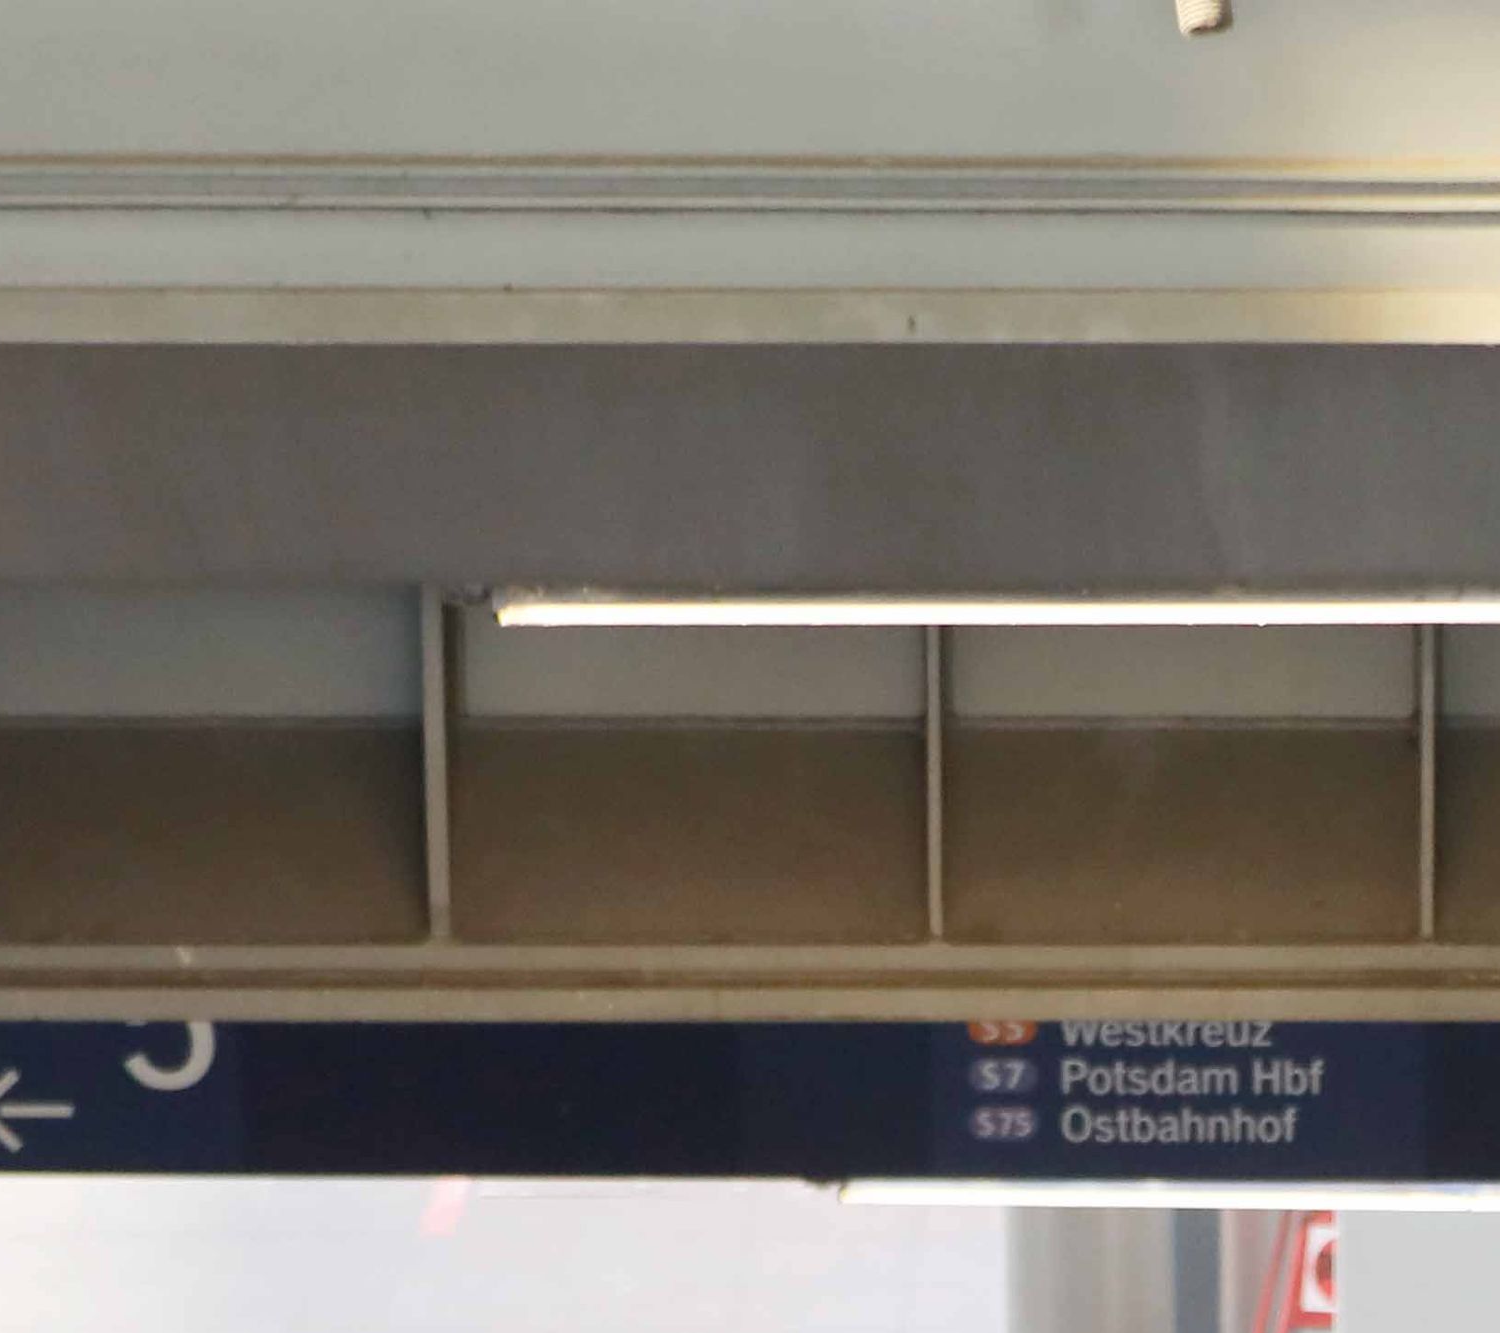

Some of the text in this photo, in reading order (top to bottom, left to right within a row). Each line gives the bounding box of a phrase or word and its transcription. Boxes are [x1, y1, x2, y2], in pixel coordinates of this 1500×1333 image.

[1061, 1020, 1273, 1047] Westkreuz
[980, 1058, 1325, 1096] S7 Potsdam Hbf
[975, 1105, 1299, 1143] S75 Ostbahnhof
